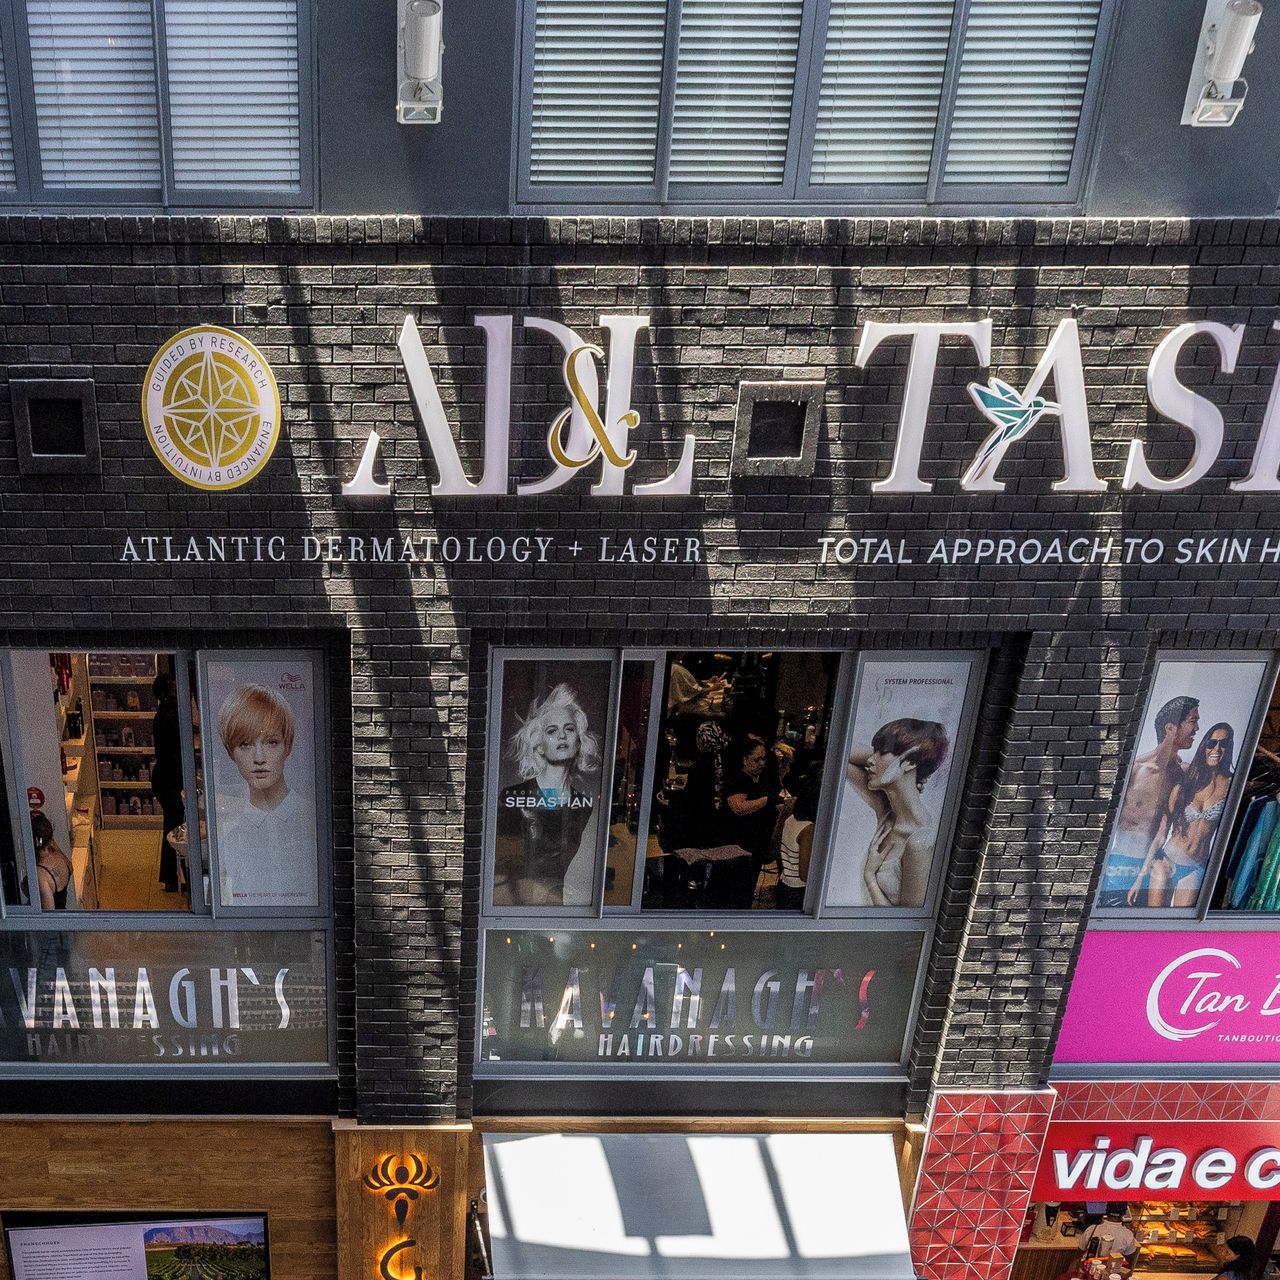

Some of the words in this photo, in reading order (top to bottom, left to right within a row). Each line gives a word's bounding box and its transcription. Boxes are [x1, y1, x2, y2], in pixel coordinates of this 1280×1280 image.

[152, 345, 185, 392] GUIDED
[189, 336, 204, 349] BY
[210, 337, 268, 389] RESEARCH
[154, 425, 202, 480] INTUITION
[227, 420, 272, 480] ENHANCED
[207, 471, 221, 482] BY
[120, 536, 287, 563] ATLANTIC
[302, 536, 554, 563] DERMATOLOGY
[598, 537, 703, 563] LASER
[817, 537, 913, 564] TOTAL
[927, 537, 1113, 564] APPROACH
[1124, 537, 1163, 564] TO
[1174, 537, 1252, 564] SKIN
[505, 797, 593, 808] SEBASTIAN
[1178, 969, 1249, 1016] Tan
[598, 1034, 814, 1057] HAIRDRESSING
[1051, 1134, 1188, 1191] vida
[1192, 1149, 1238, 1190] e
